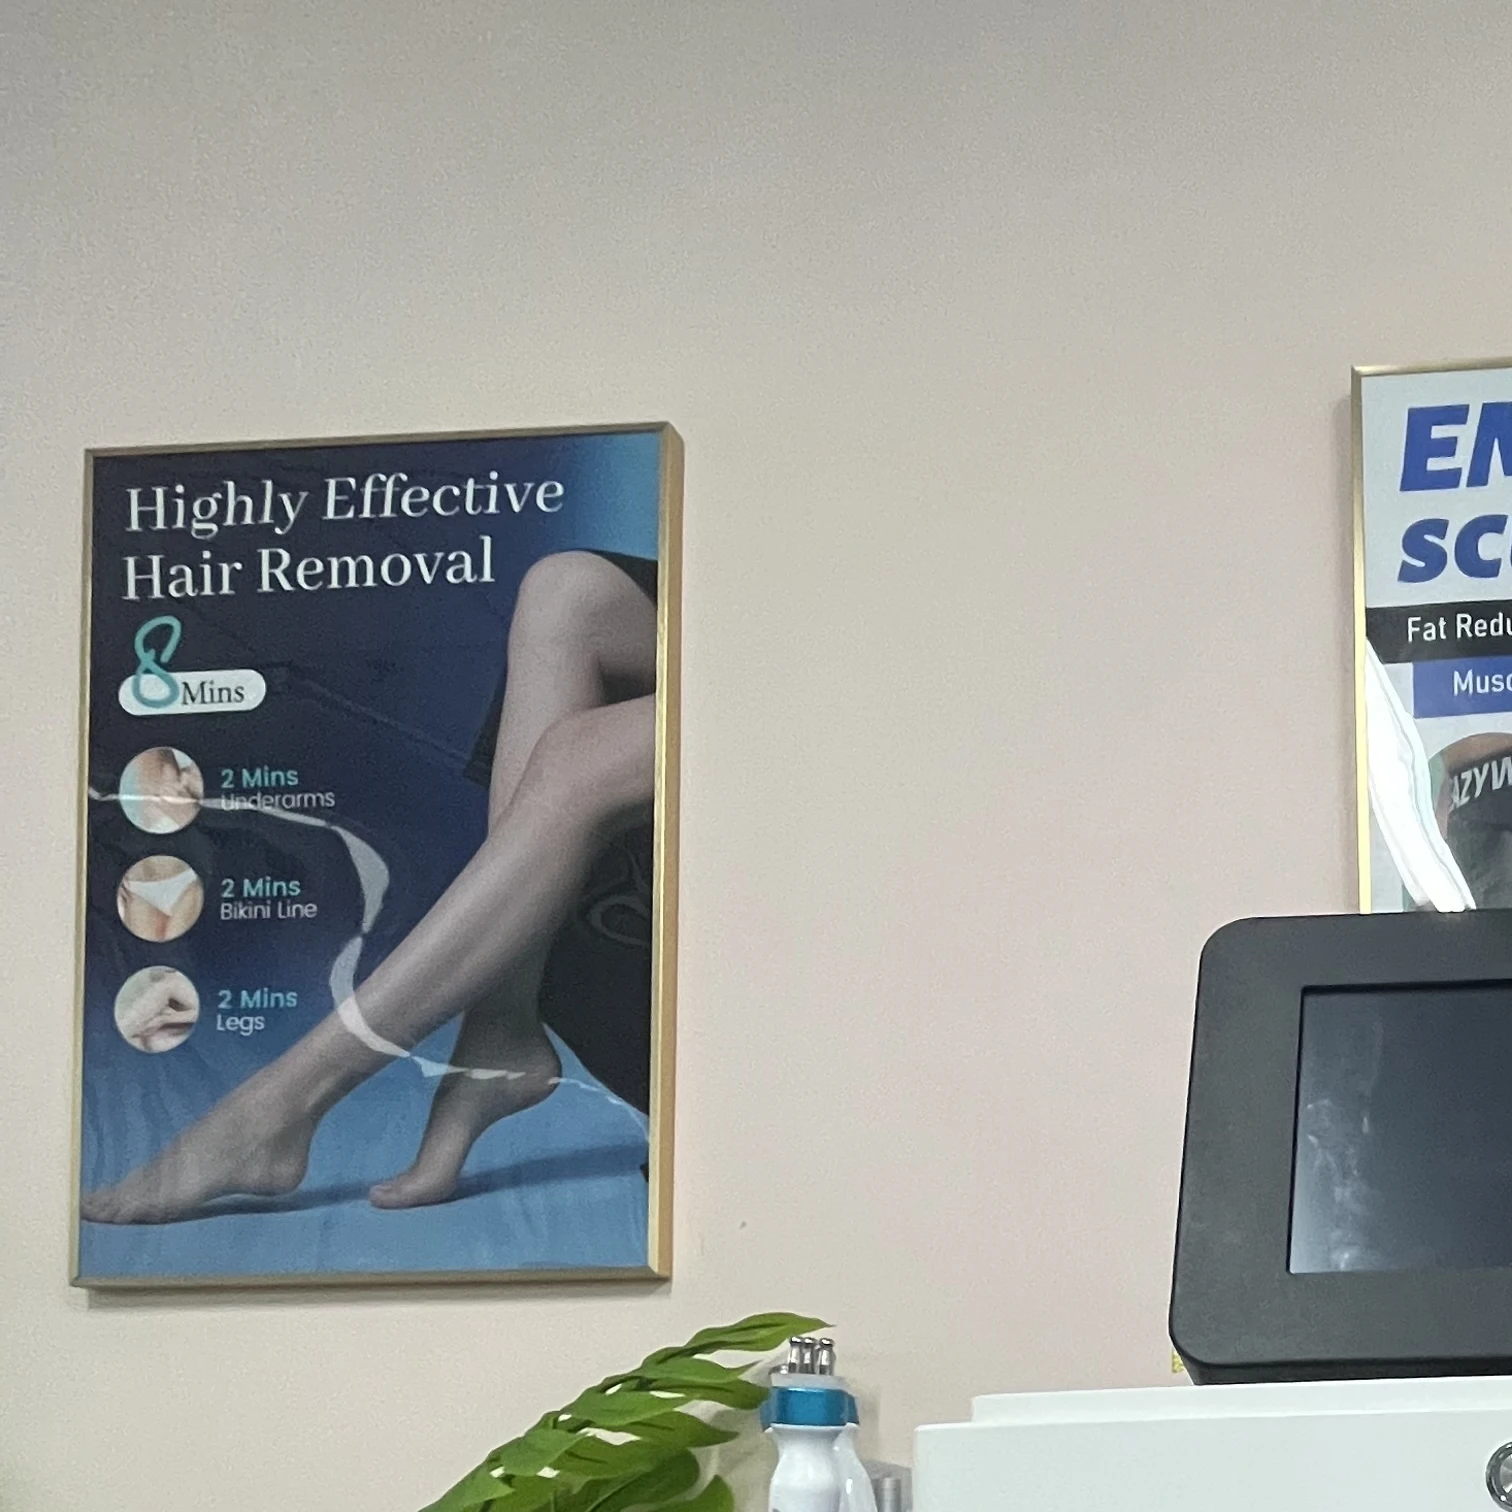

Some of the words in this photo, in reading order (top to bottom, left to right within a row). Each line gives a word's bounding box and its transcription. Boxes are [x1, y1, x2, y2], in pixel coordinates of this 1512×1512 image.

[125, 481, 308, 539] Highly
[321, 470, 565, 521] Effective
[121, 550, 242, 600] Hair
[256, 535, 496, 592] Removal
[1406, 616, 1447, 643] Fat
[131, 615, 182, 709] 8
[181, 679, 246, 707] Mins
[220, 768, 236, 789] 2
[241, 764, 299, 789] Mins
[219, 788, 336, 812] Underarms
[220, 878, 236, 899] 2
[241, 875, 301, 899] Mins
[219, 899, 272, 920] Bikini
[276, 898, 318, 919] Line
[217, 989, 233, 1010] 2
[239, 986, 298, 1010] Mins
[216, 1011, 266, 1034] Legs
